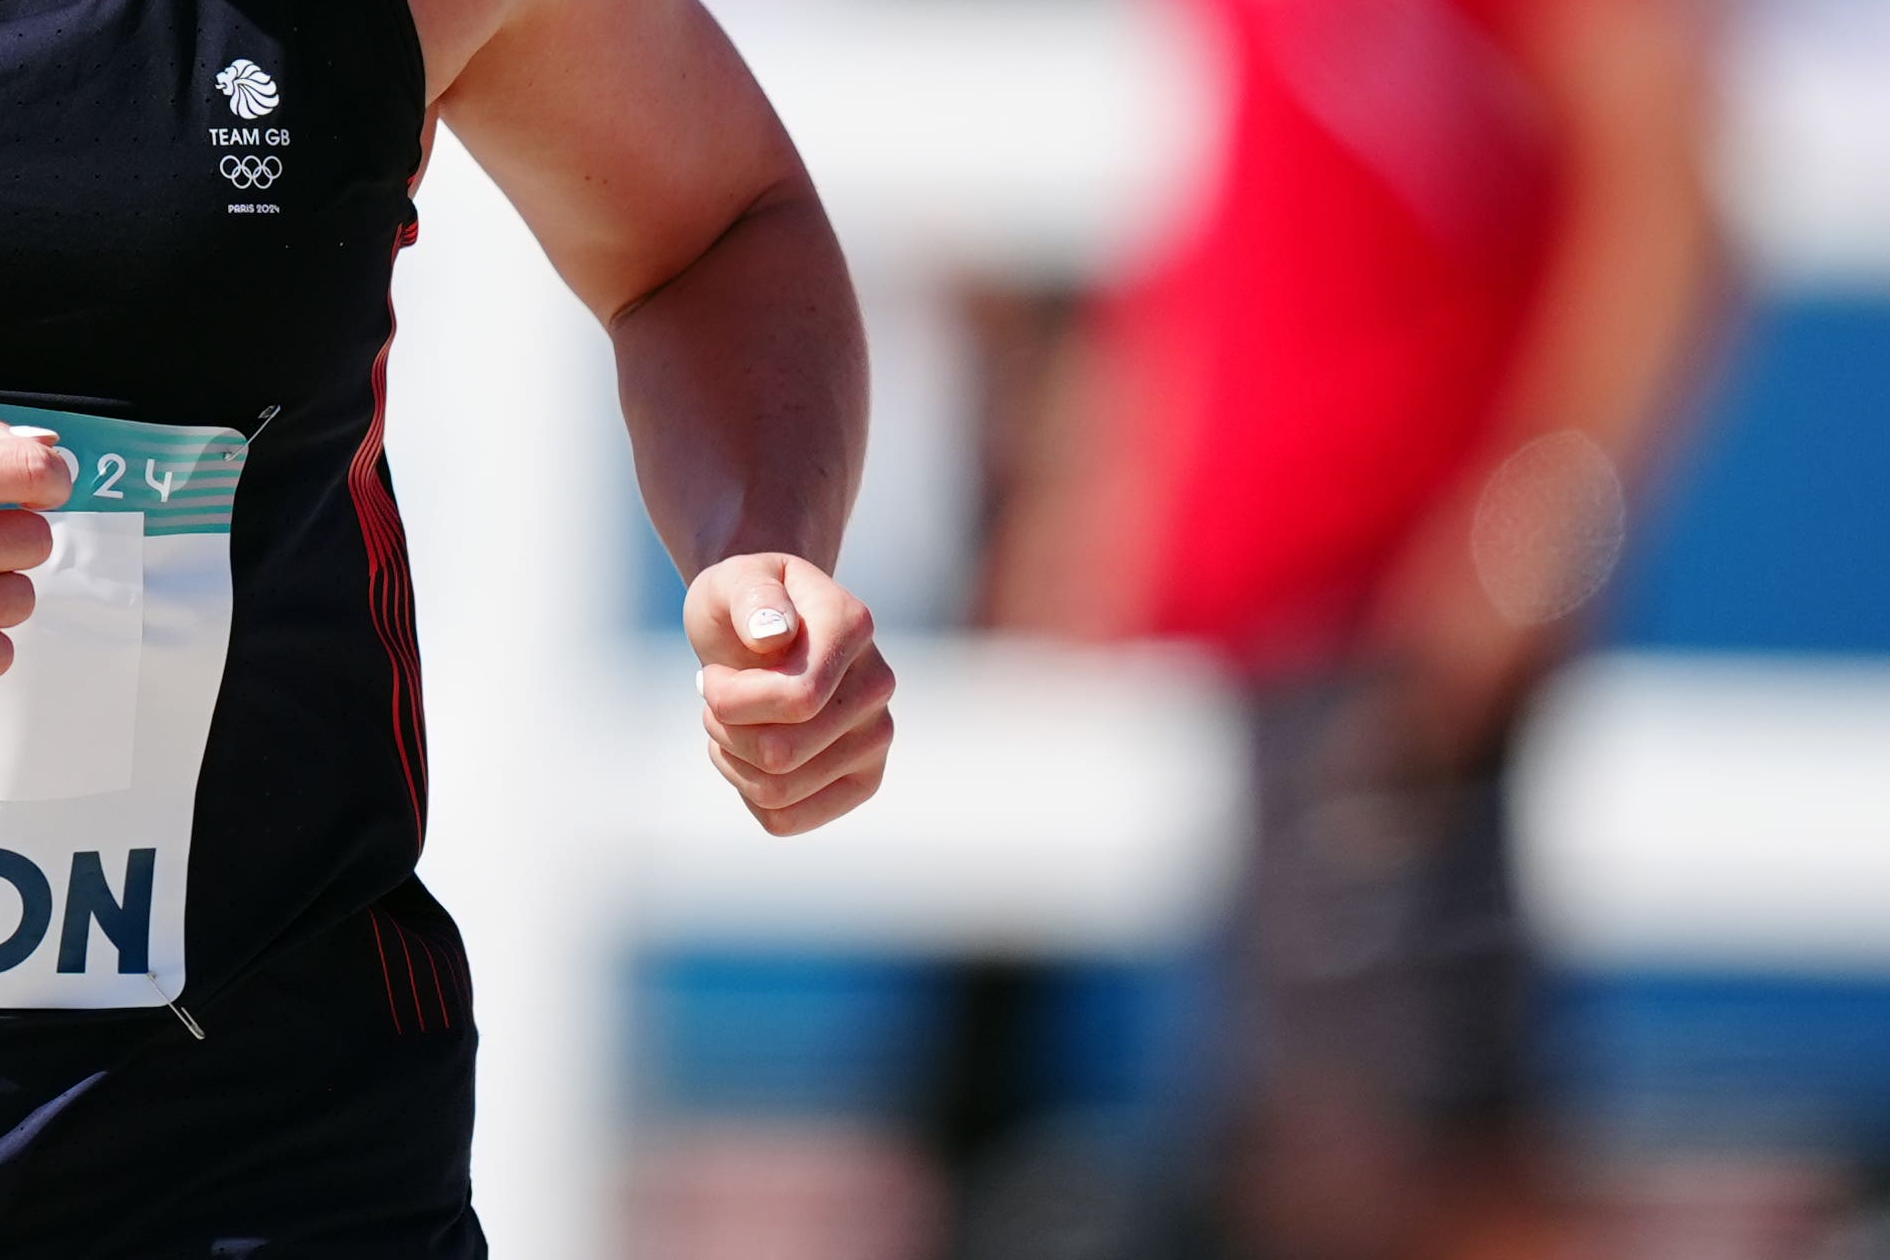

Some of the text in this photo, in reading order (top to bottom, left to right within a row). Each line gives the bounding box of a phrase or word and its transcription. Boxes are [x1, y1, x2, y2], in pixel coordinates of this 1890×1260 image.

[208, 127, 291, 146] TEAM GB
[256, 204, 280, 214] 2024
[52, 445, 174, 503] 24
